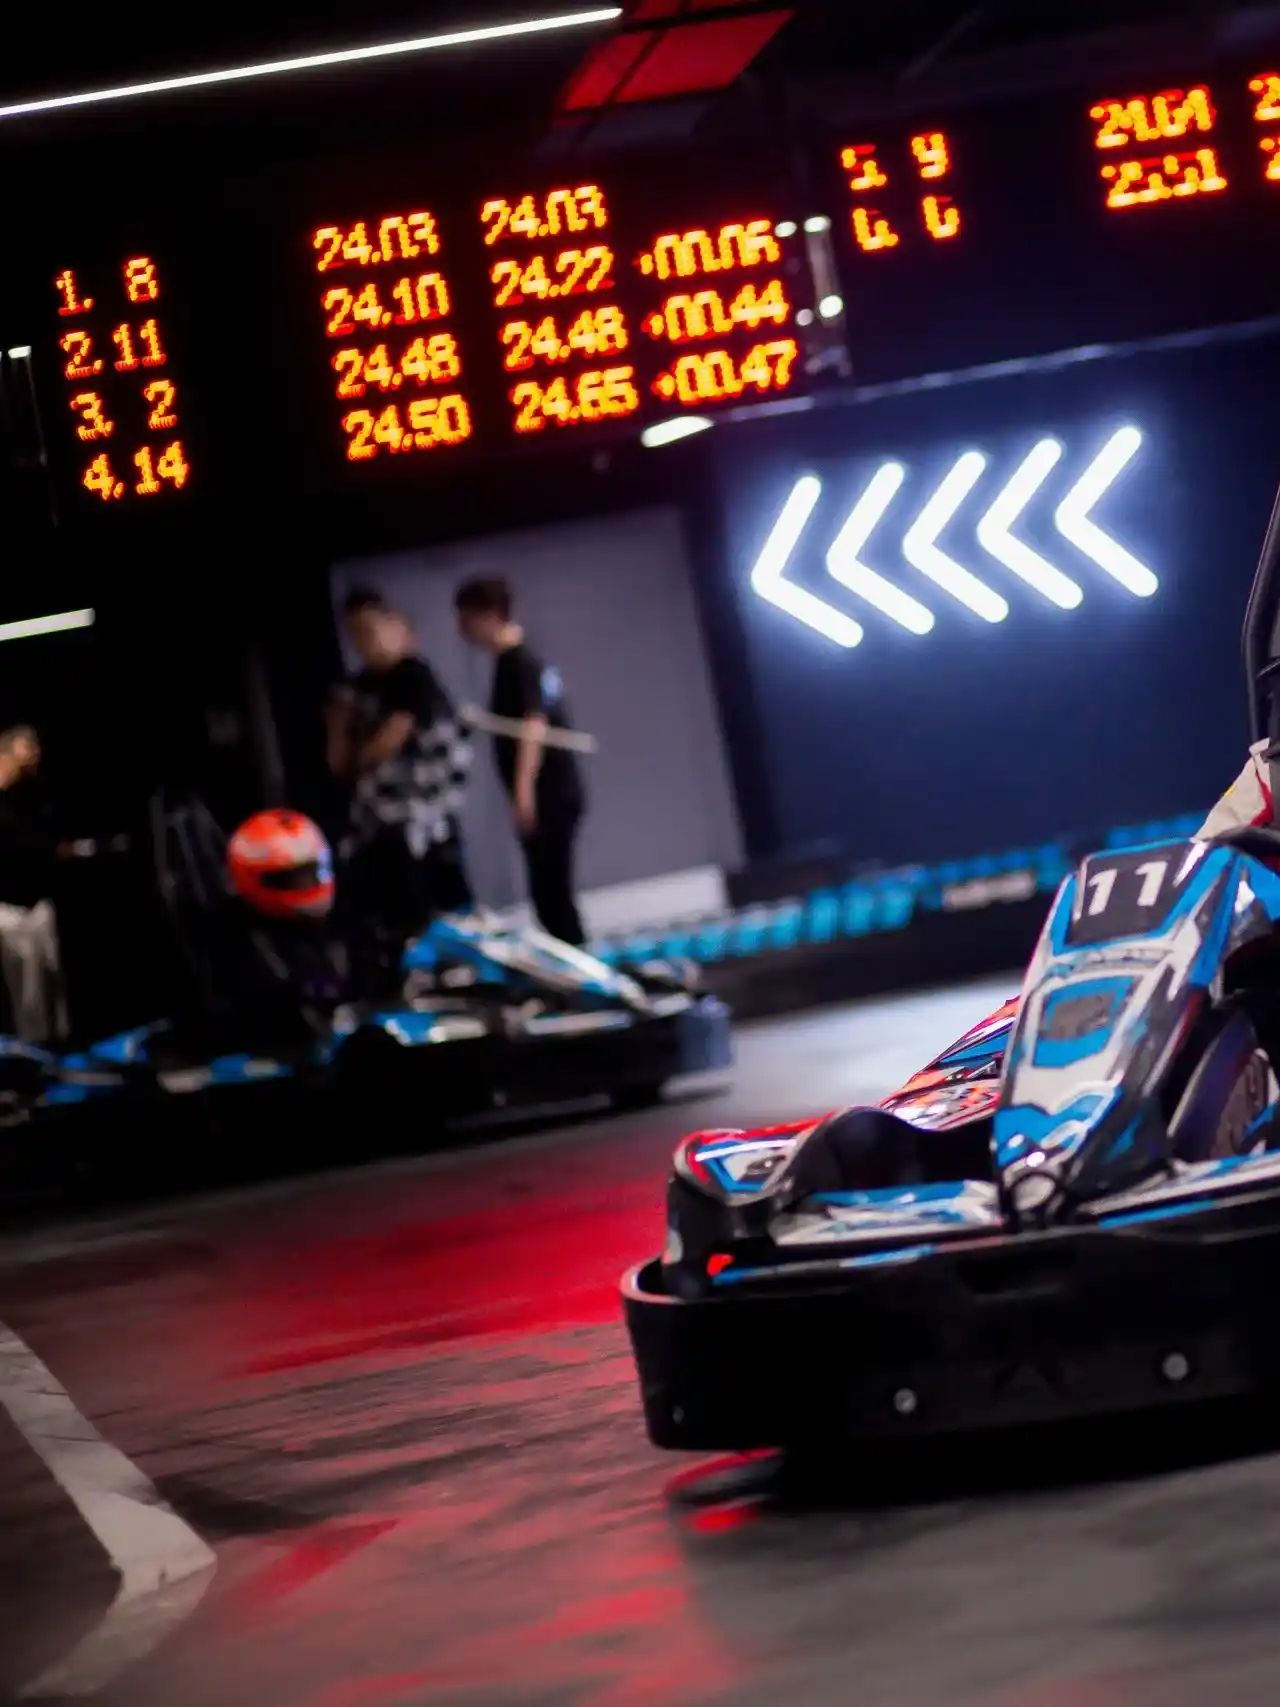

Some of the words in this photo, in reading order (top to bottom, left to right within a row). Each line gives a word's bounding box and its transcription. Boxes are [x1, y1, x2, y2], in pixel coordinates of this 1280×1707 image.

[56, 271, 92, 315] 1.
[124, 258, 158, 302] 8
[60, 332, 102, 379] 2.
[113, 320, 166, 371] 11
[321, 272, 450, 336] 24.10
[144, 380, 176, 429] 2
[331, 333, 461, 399] 24.48
[499, 305, 629, 372] 24.48
[84, 454, 124, 500] 4.
[135, 441, 189, 494] 14
[342, 394, 472, 460] 24.50
[509, 365, 639, 432] 24.65
[1087, 861, 1168, 916] 11
